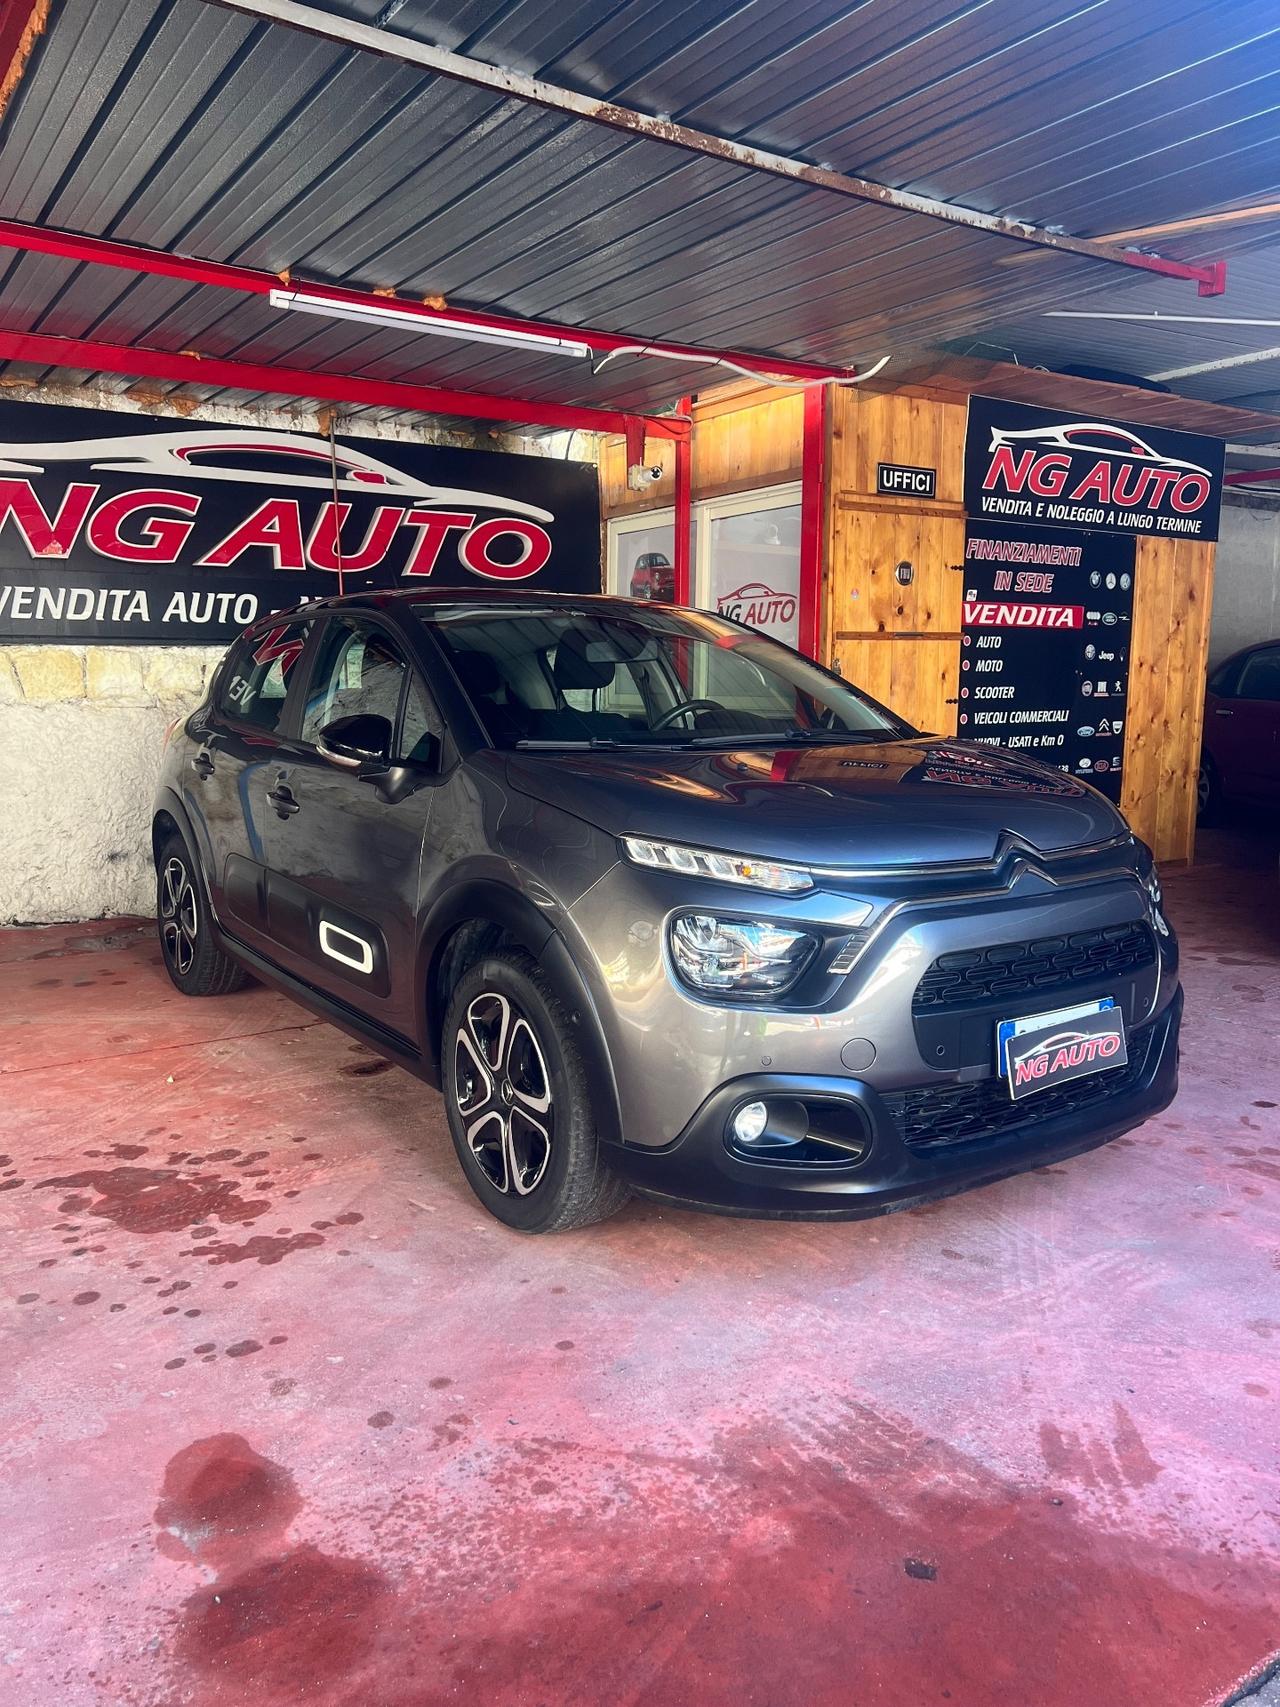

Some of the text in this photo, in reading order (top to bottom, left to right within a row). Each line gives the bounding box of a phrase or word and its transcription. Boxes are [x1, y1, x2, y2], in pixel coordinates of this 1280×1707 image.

[883, 469, 931, 492] UFFICI
[982, 446, 1211, 513] NG AUTO
[981, 496, 1202, 534] VENDITA E NOLEGGIO A LUNGO TERMINE
[0, 478, 553, 580] NG AUTO
[966, 538, 1082, 566] FINANZIAMENTI
[993, 570, 1054, 593] IN SEDE
[162, 591, 258, 624] AUTO
[744, 599, 796, 625] AUTO
[963, 603, 1074, 627] VENDITA
[976, 635, 1002, 649] AUTO
[975, 660, 1003, 673] MOTO
[1098, 650, 1115, 661] Jeep
[974, 686, 1015, 699] SCOOTER
[974, 709, 1070, 725] VEICOLI COMMERCIALI
[1008, 736, 1032, 748] USATI
[1033, 738, 1038, 747] e
[1040, 735, 1055, 747] Km
[1015, 1035, 1121, 1086] NG AUTO
